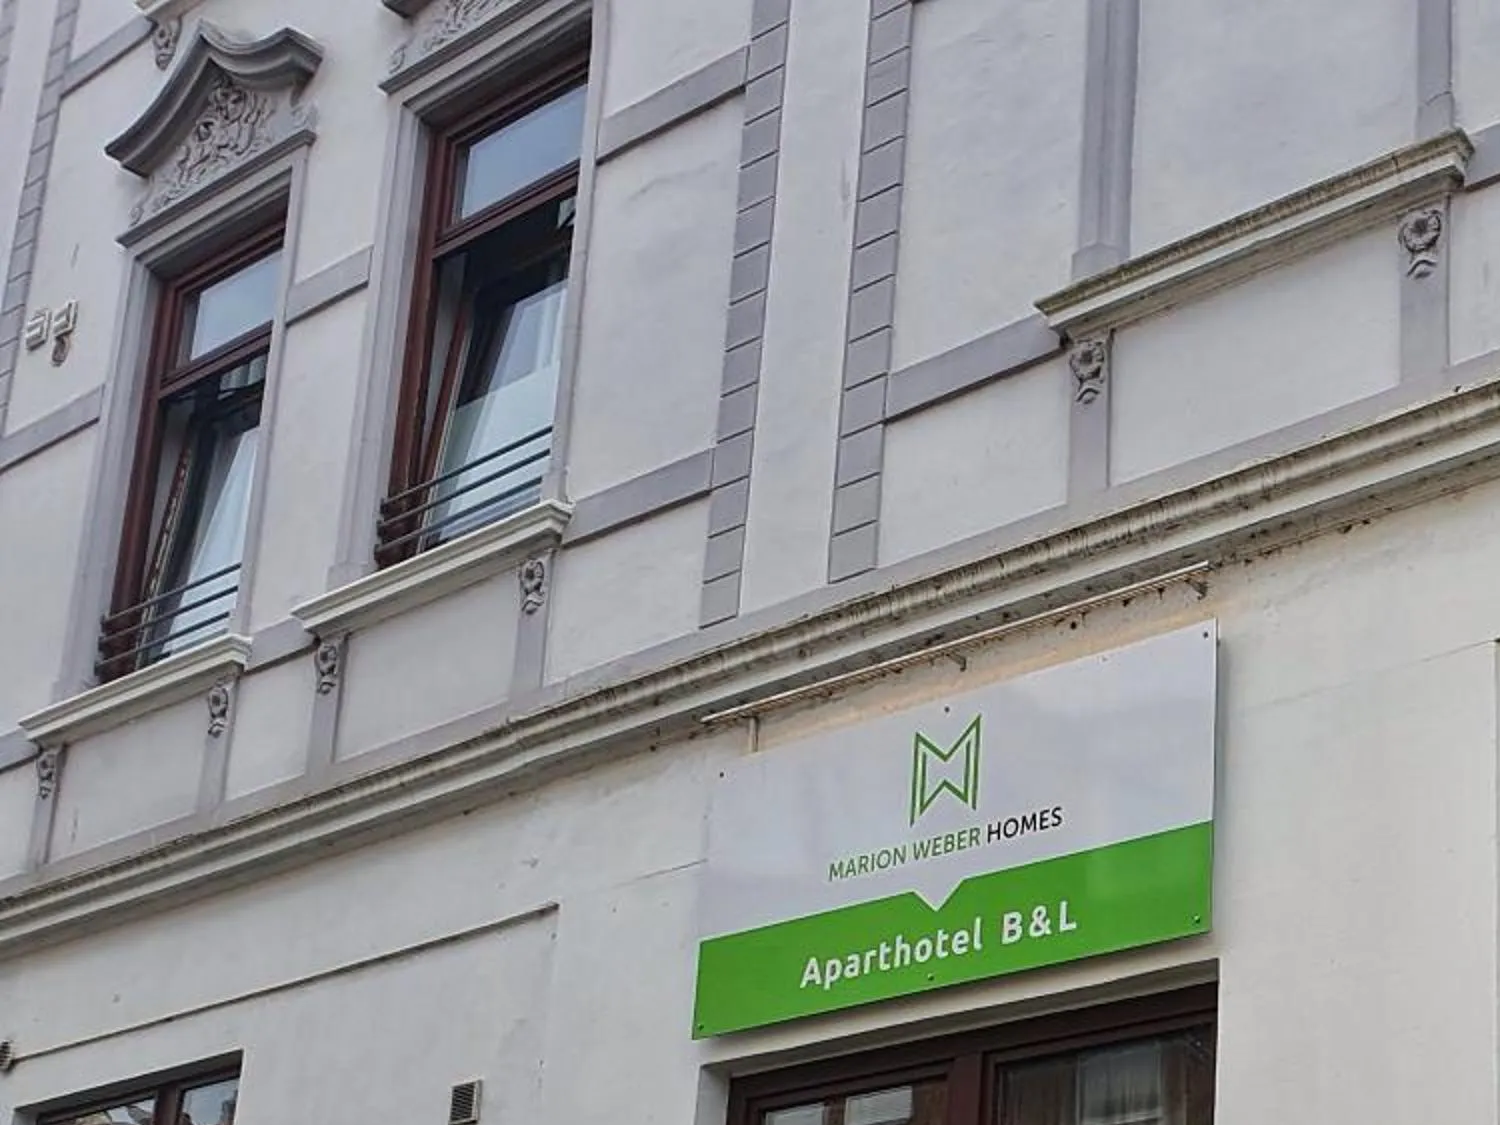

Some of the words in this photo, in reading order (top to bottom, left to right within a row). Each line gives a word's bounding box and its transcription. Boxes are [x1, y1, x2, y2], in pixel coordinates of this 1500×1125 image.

[828, 845, 907, 882] MARION
[913, 827, 981, 861] WEBER
[986, 806, 1063, 843] HOMES
[800, 917, 983, 990] Aparthotel
